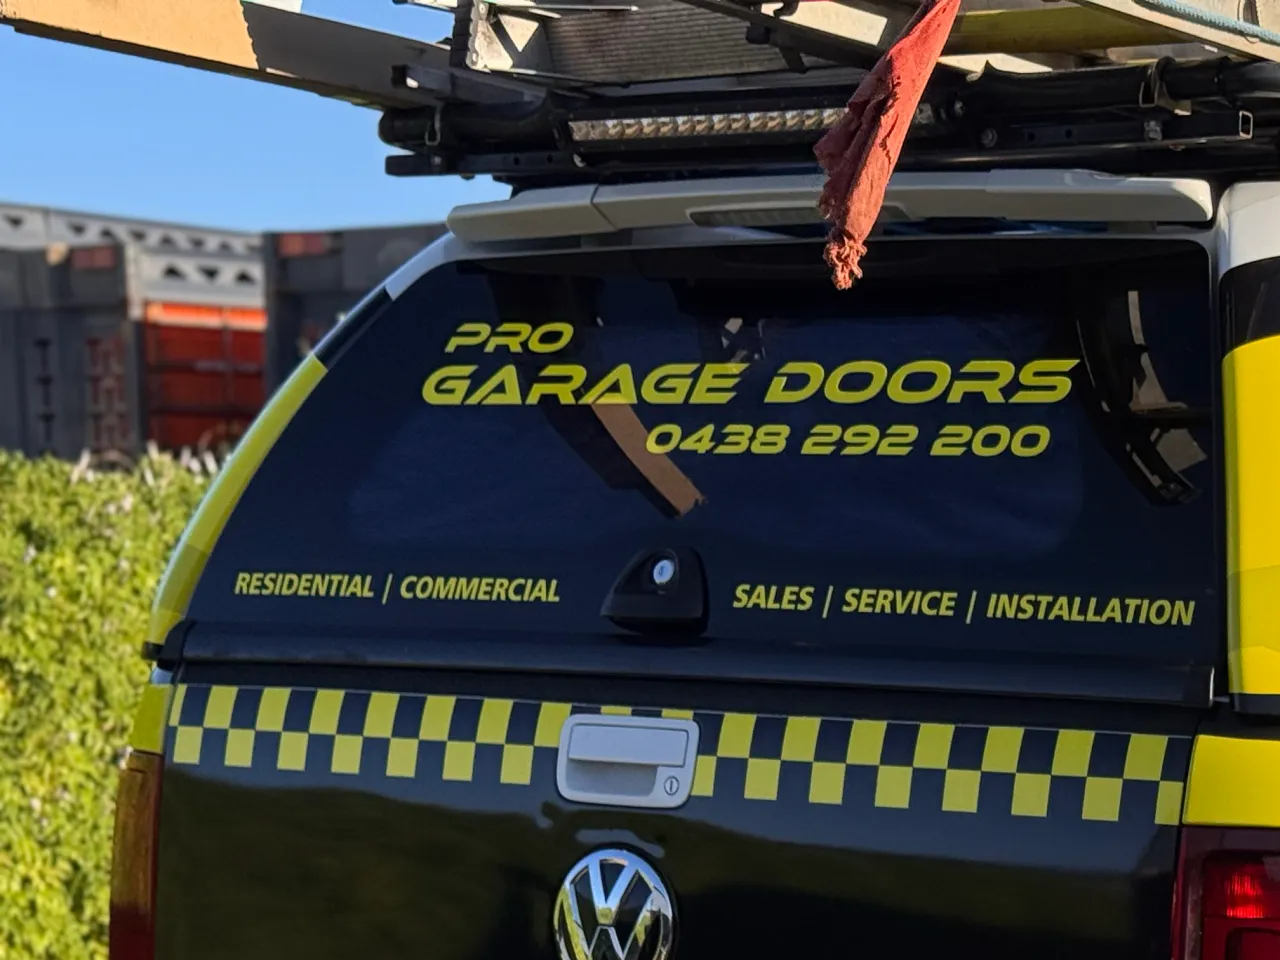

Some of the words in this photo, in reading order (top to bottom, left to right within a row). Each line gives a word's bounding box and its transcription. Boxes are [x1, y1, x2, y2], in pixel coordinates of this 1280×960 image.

[444, 322, 574, 354] PRO
[421, 363, 750, 405] GARAGE
[763, 358, 1082, 404] DOORS
[645, 423, 791, 455] 0438
[799, 423, 919, 456] 292
[929, 424, 1051, 458] 200
[233, 571, 375, 598] RESIDENTIAL
[399, 574, 561, 603] COMMERCIAL
[732, 583, 815, 611] SALES
[841, 587, 958, 617] SERVICE
[986, 592, 1196, 626] INSTALLATION
